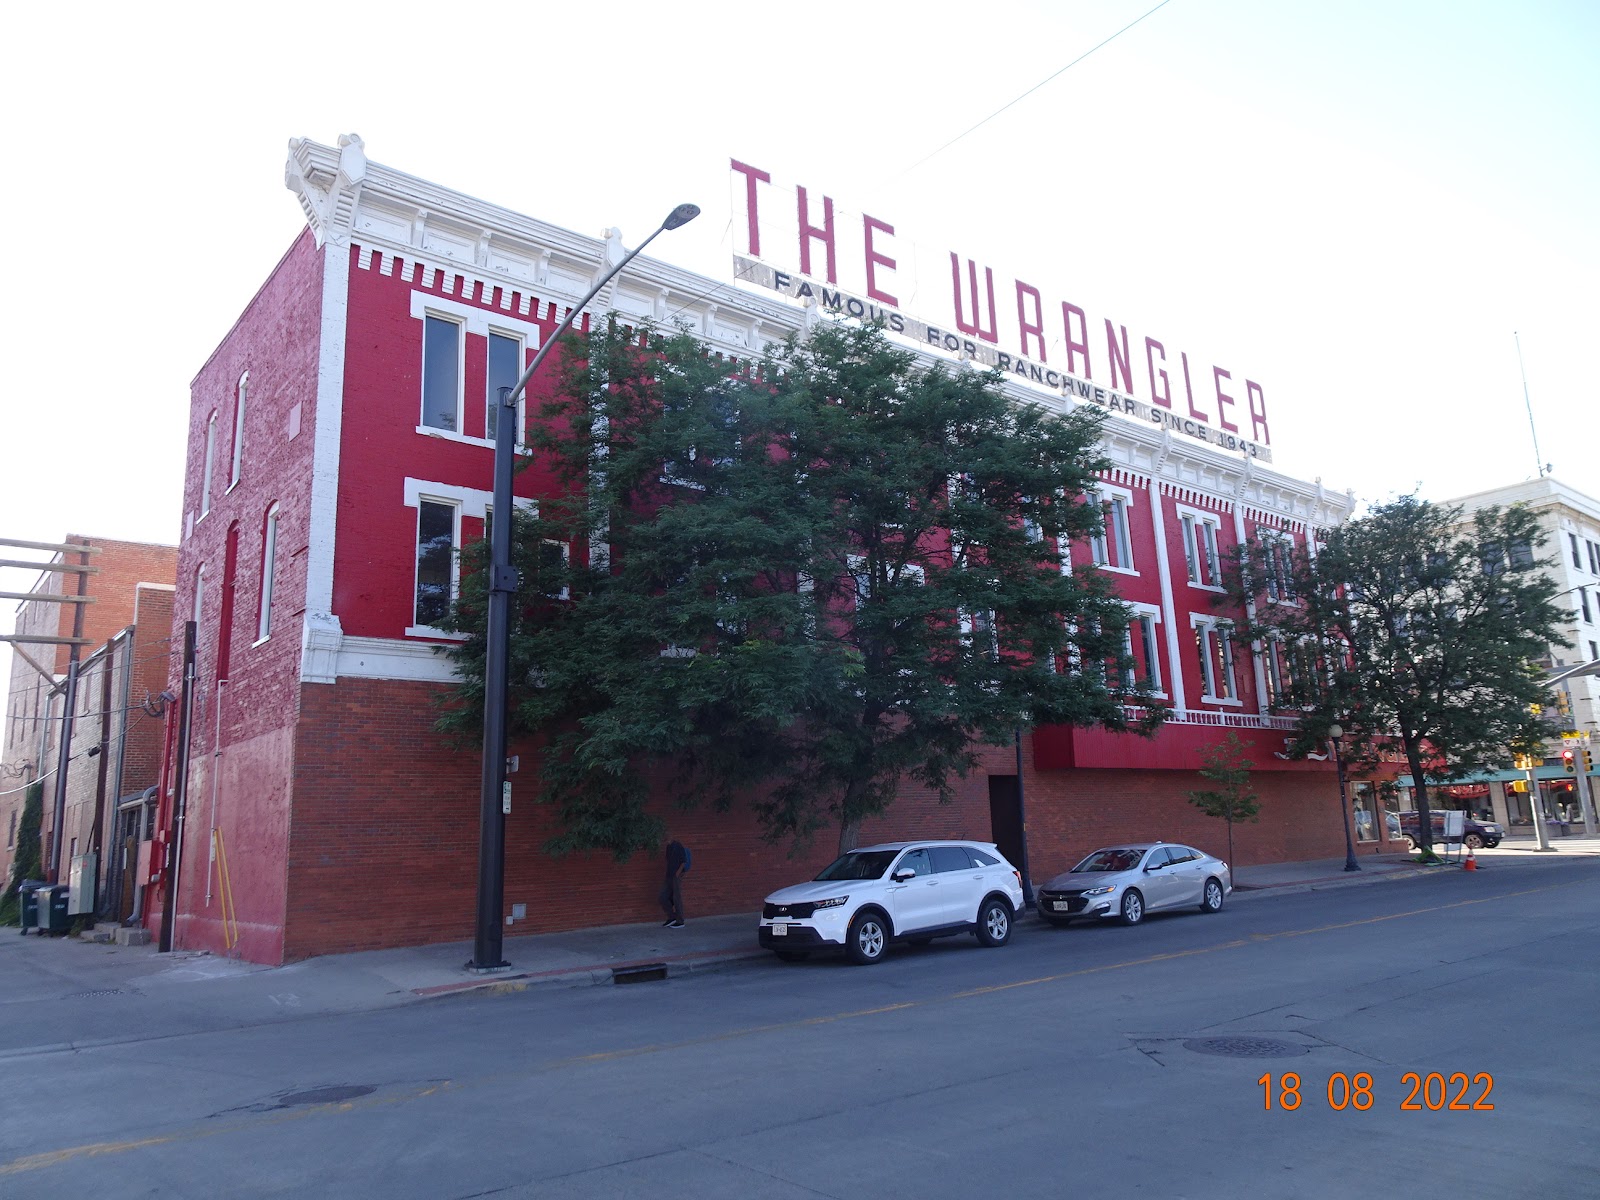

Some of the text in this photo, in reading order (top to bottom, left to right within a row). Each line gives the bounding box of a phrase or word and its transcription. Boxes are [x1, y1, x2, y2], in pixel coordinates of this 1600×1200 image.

[730, 157, 1271, 446] THE WRANGLER
[774, 270, 1257, 457] FAMOUS FOR RANCHWEAR SINCE 1943
